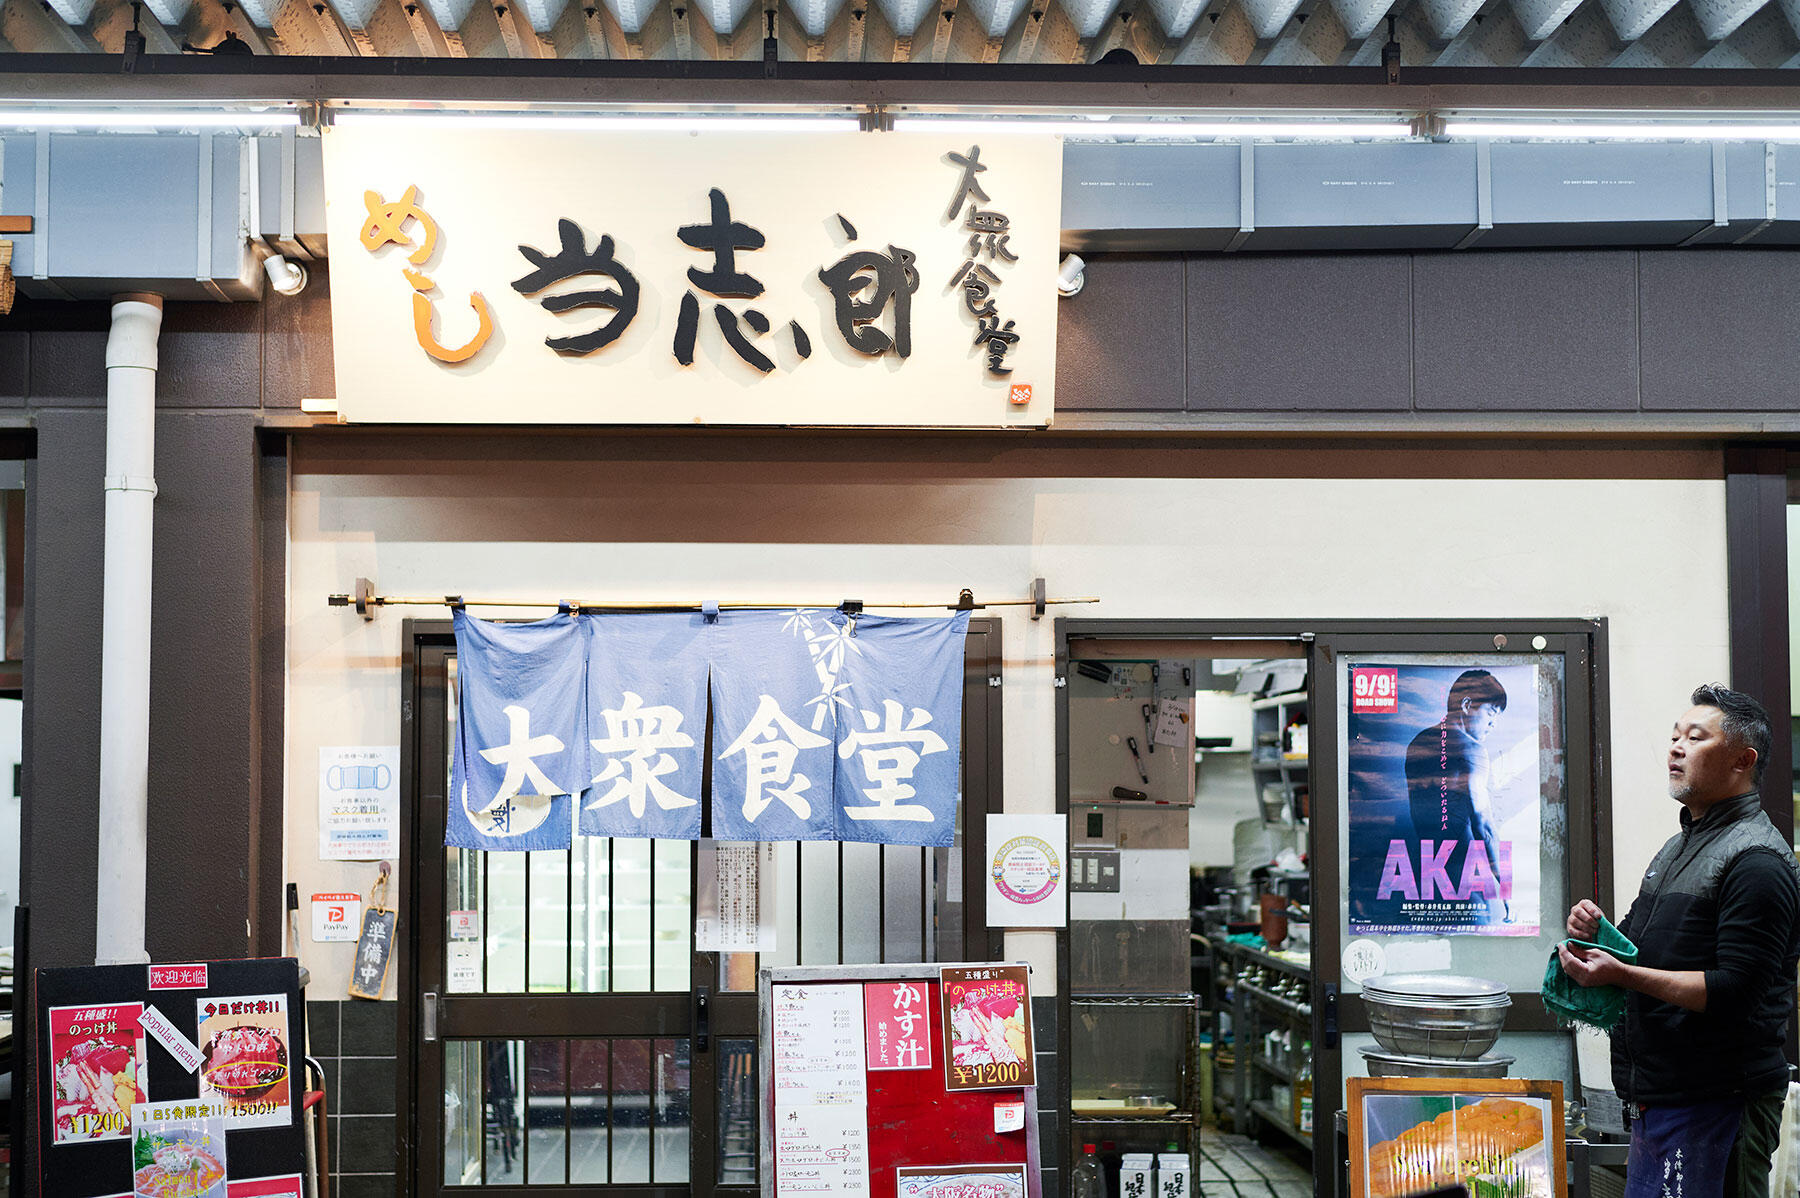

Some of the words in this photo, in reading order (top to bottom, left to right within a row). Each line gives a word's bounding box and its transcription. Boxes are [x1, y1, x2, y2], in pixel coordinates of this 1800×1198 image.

[359, 185, 494, 363] めし
[511, 187, 919, 373] 当志郎
[1355, 674, 1390, 696] 9/9
[478, 691, 948, 822] 大衆食堂
[1376, 840, 1512, 901] AKAI
[360, 920, 388, 985] 準備中
[151, 969, 206, 985] 欢迎光临
[69, 1022, 118, 1036] のっけ丼
[141, 1011, 178, 1051] popular
[175, 1043, 198, 1069] menu
[892, 983, 924, 1067] かす汁
[953, 1062, 1021, 1084] ¥1200
[69, 1112, 125, 1134] ¥1200
[151, 1135, 210, 1150] サーモン丼
[154, 1174, 191, 1186] Salmon
